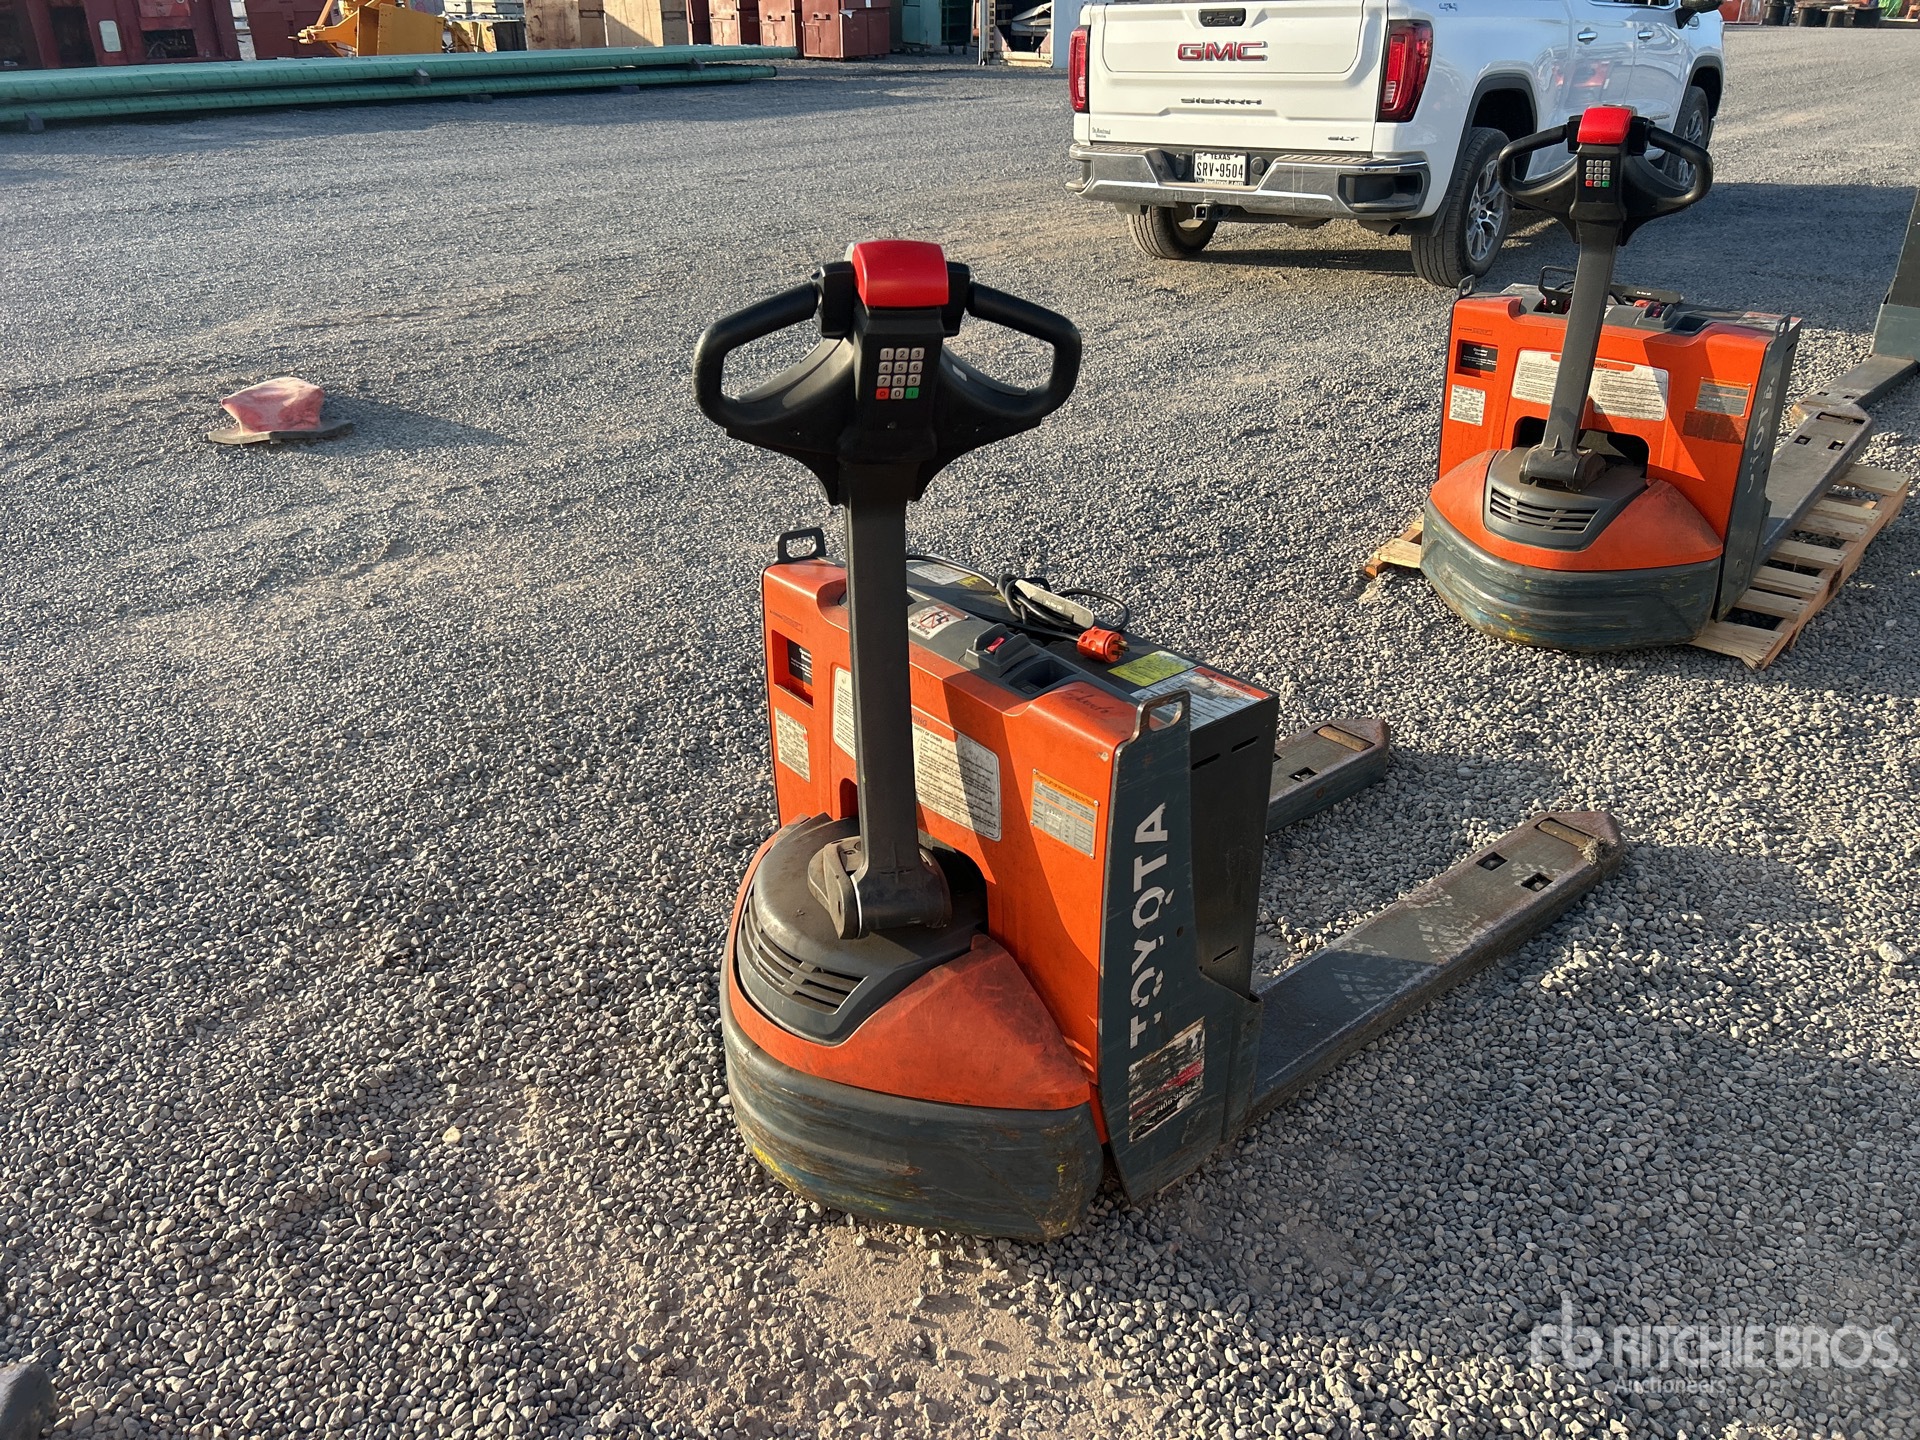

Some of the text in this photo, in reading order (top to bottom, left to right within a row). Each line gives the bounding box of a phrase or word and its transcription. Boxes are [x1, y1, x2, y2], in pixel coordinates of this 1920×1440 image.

[1177, 41, 1268, 61] GMC
[1210, 153, 1231, 161] TEXAS
[1196, 162, 1243, 179] SRV 9504
[1130, 802, 1174, 1049] TOYOTA
